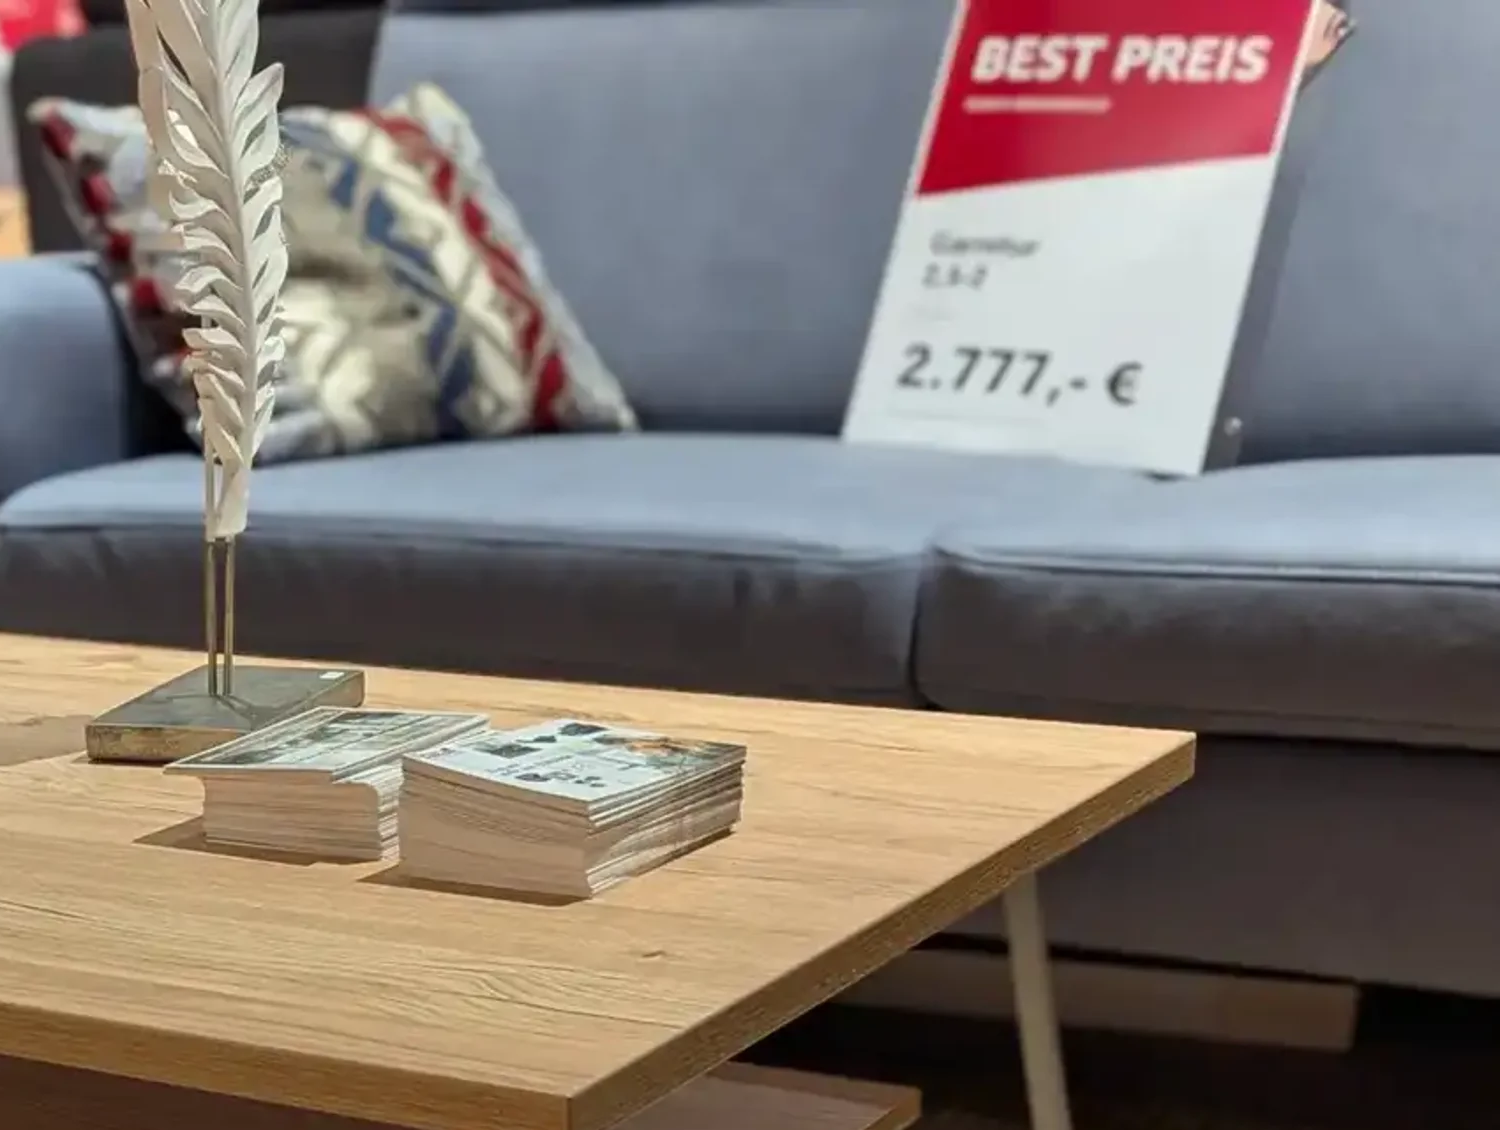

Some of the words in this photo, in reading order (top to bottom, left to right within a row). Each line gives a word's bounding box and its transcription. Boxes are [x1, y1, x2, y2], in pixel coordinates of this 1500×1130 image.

[970, 33, 1109, 84] BEST
[1111, 33, 1274, 85] PREIS
[1106, 360, 1144, 407] €
